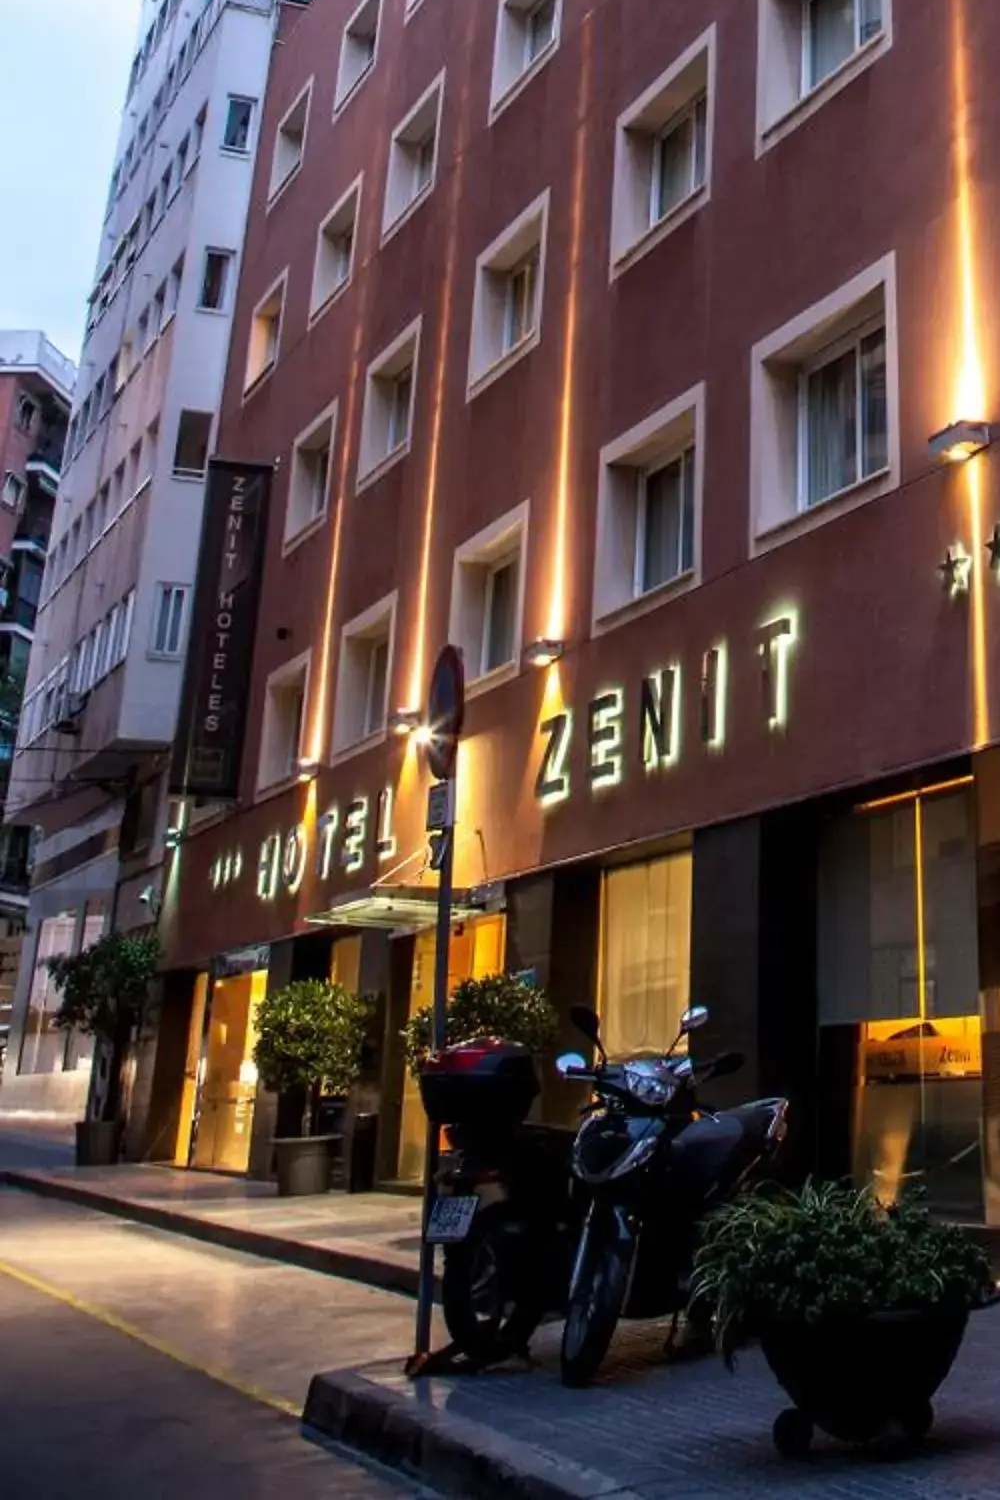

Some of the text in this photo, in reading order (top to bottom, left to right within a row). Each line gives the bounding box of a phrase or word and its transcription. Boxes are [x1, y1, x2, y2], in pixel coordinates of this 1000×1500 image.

[225, 475, 245, 569] ZENIT
[204, 591, 234, 733] HOTELES
[256, 608, 799, 901] HOTEL ZENIT
